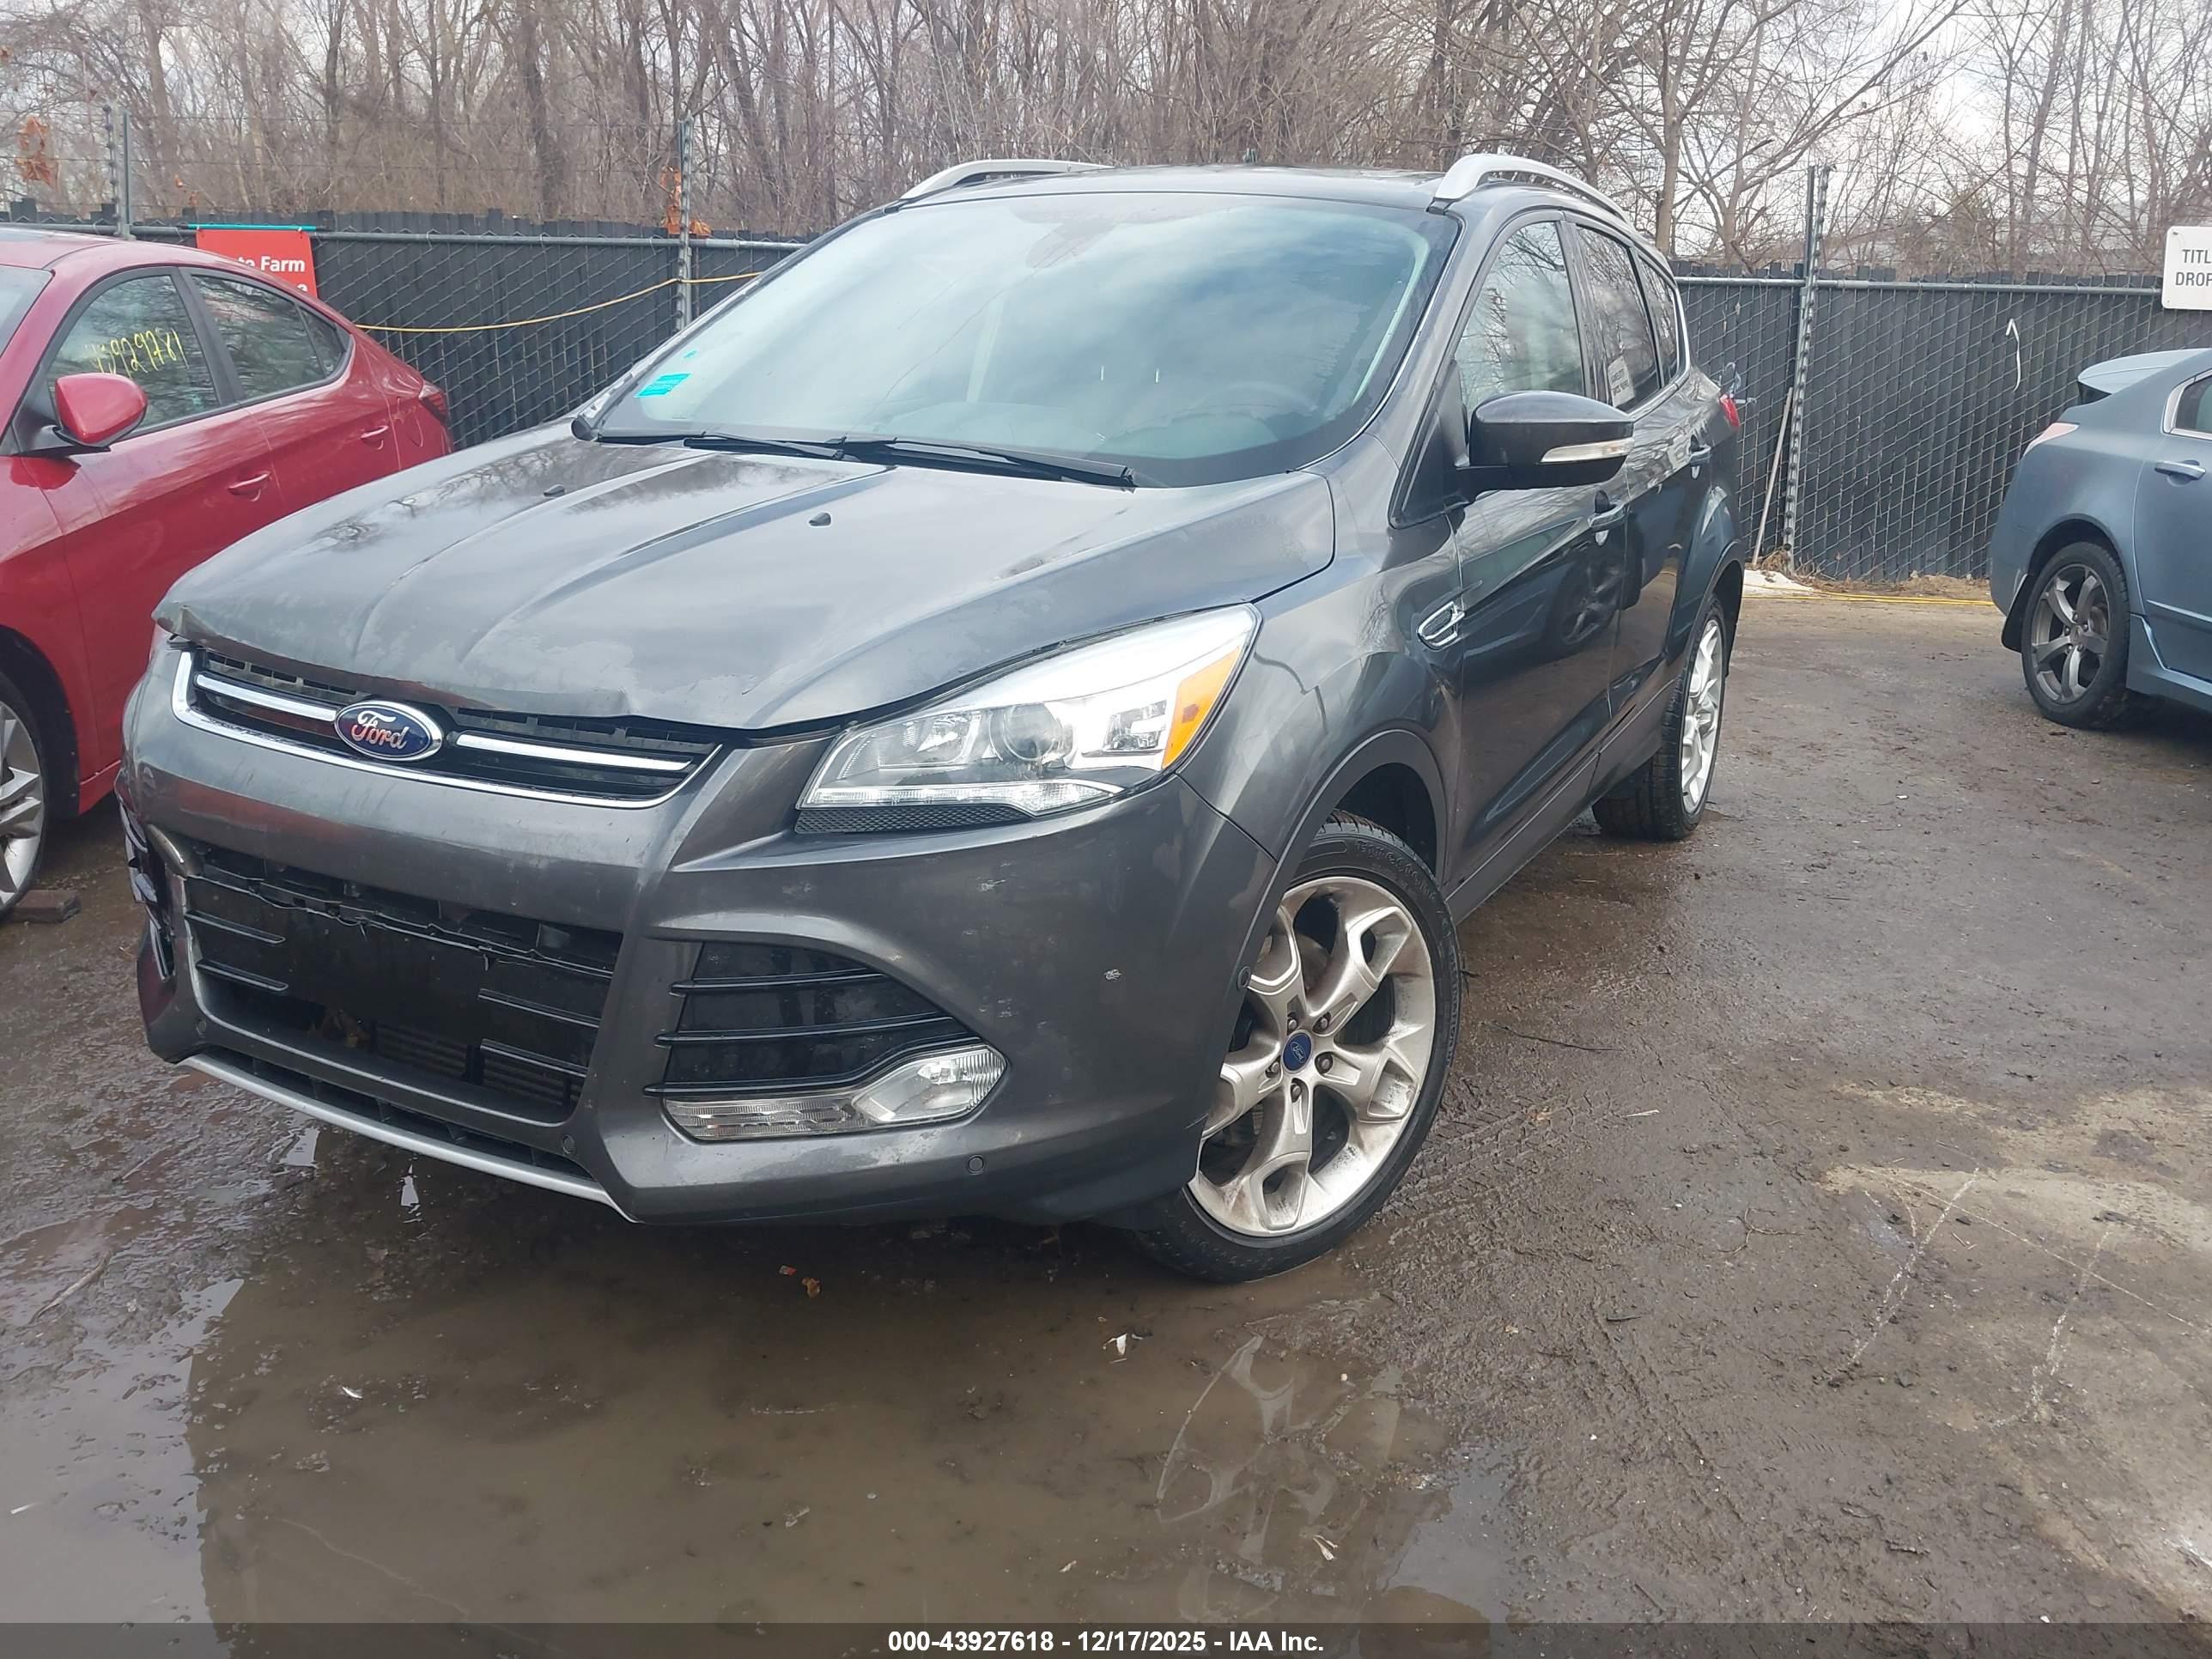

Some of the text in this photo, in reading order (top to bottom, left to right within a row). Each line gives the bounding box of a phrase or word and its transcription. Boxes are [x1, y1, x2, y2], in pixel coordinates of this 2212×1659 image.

[260, 255, 306, 272] Farm
[2182, 249, 2212, 264] TITL
[2175, 271, 2212, 287] DROP
[350, 710, 410, 750] Ford
